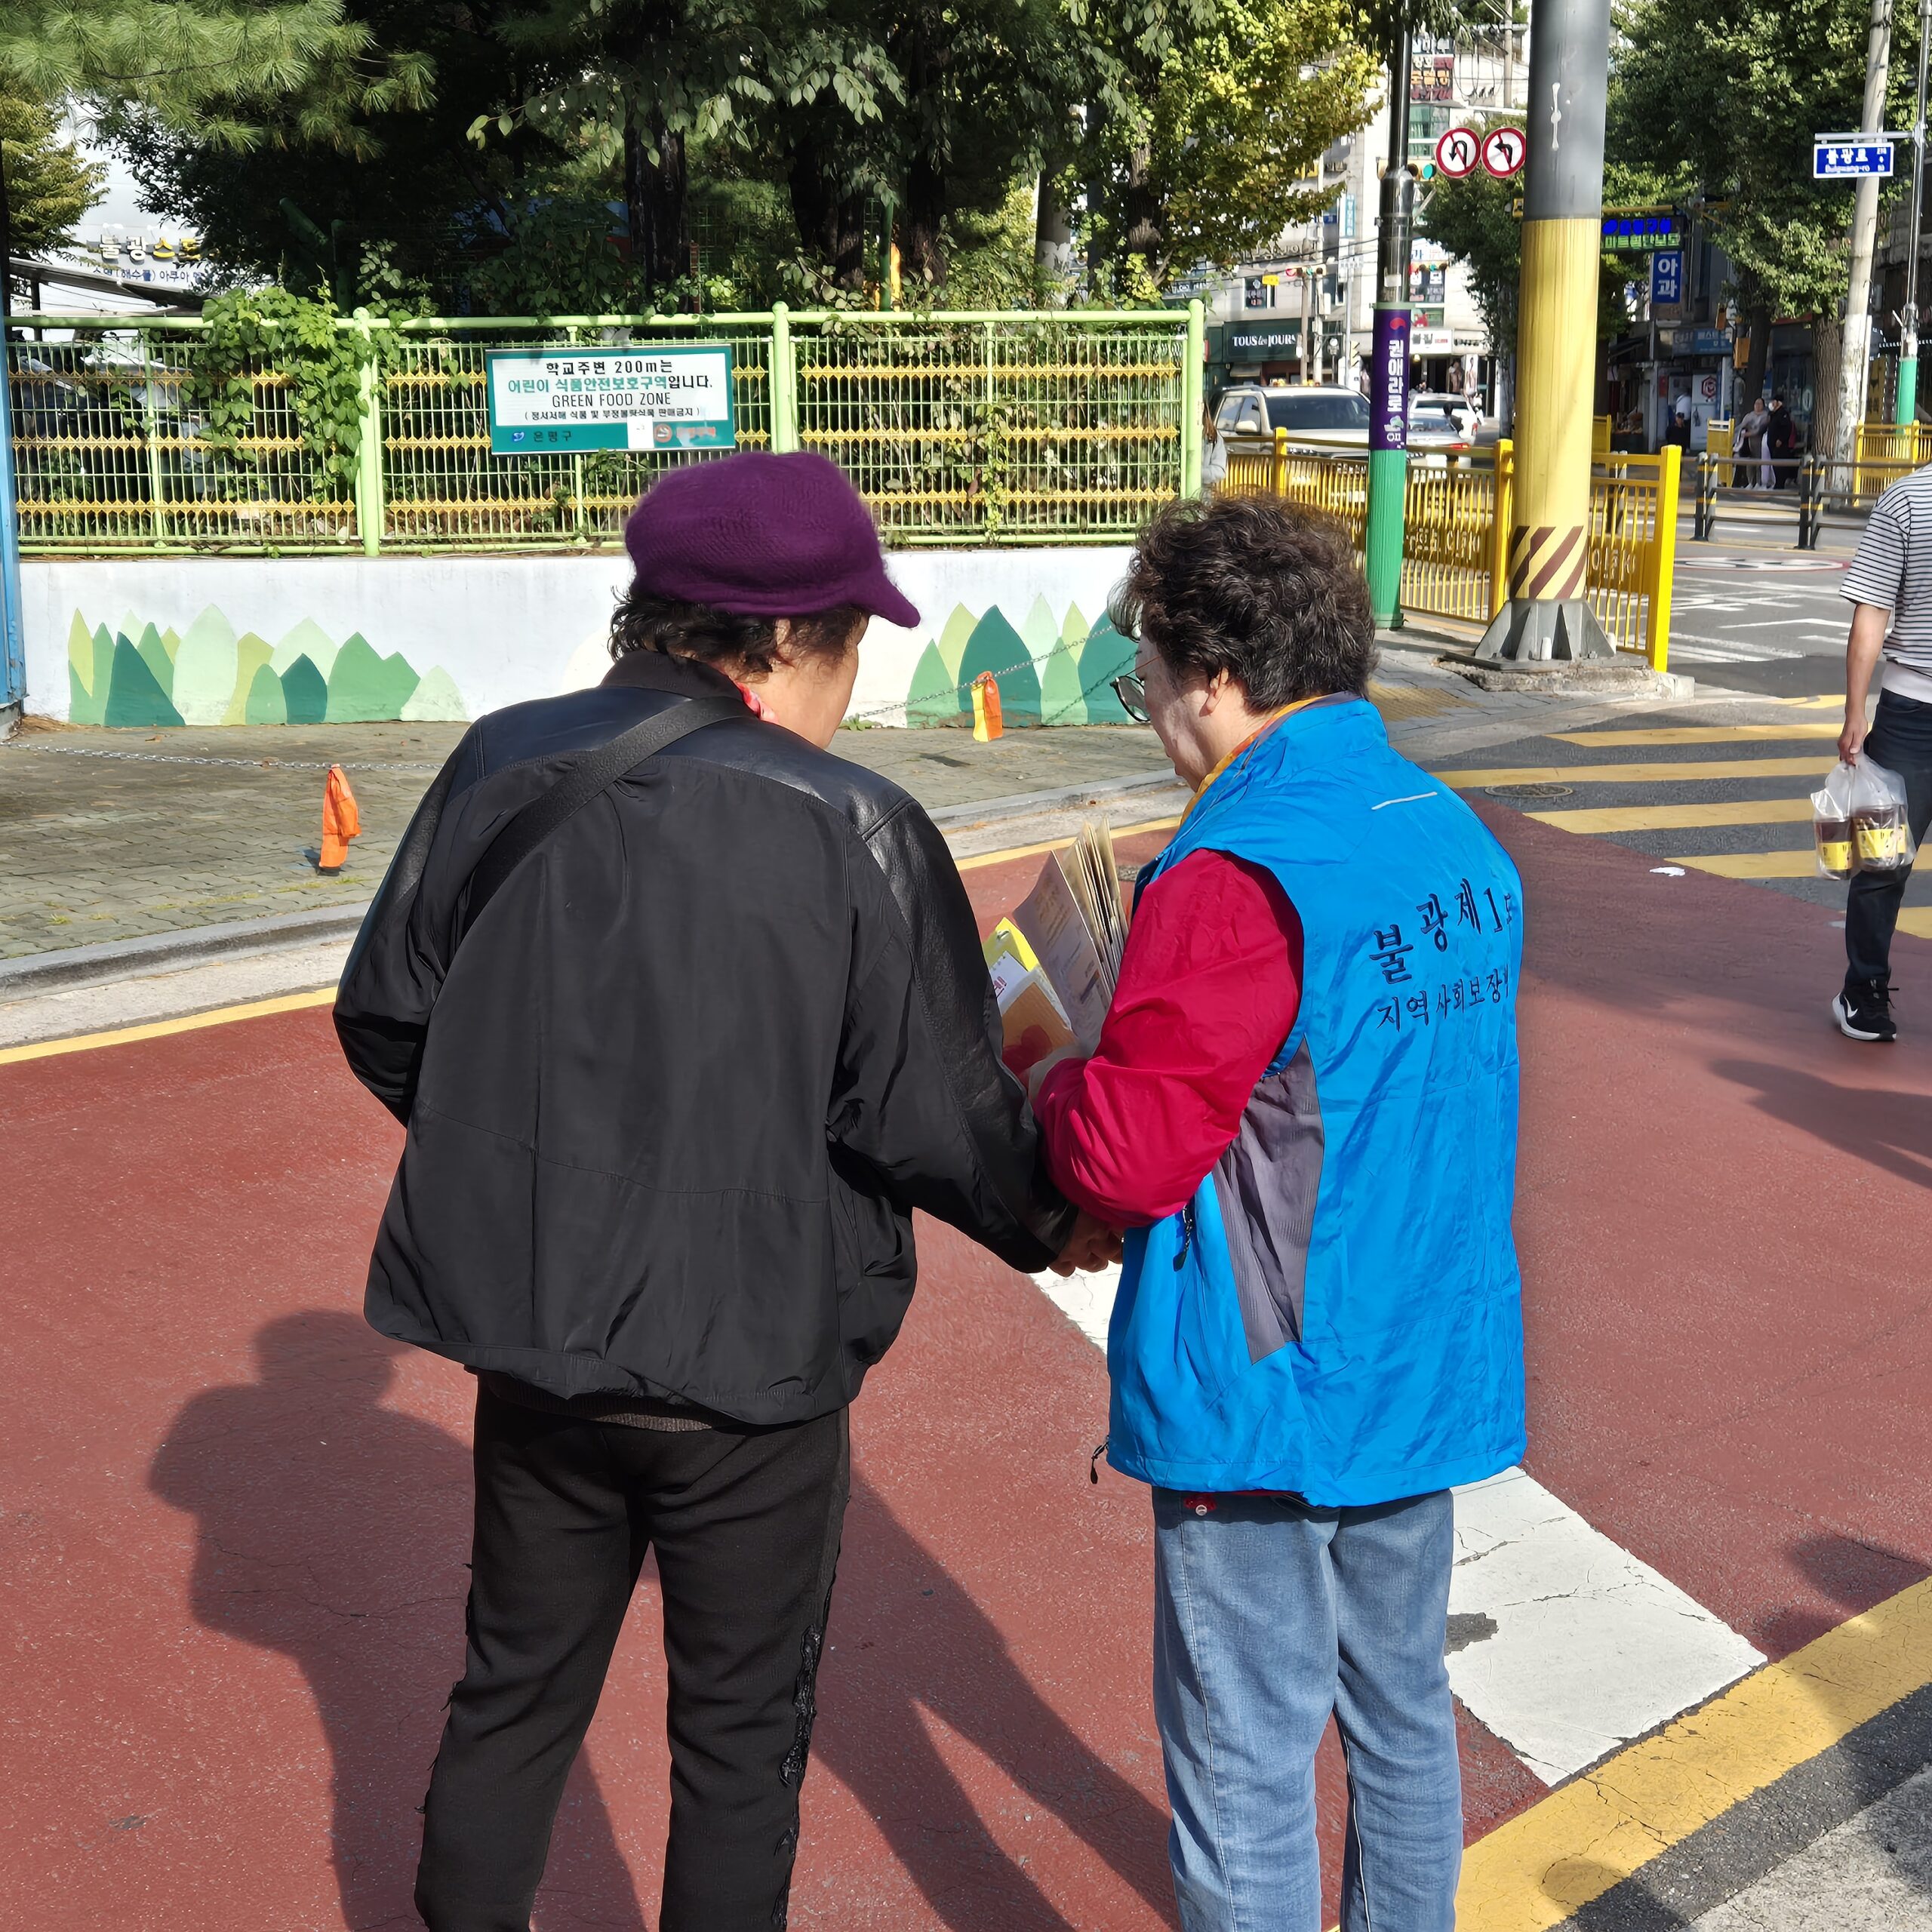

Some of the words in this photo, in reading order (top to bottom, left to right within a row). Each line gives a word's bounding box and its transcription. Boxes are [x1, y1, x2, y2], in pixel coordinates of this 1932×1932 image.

[1232, 335, 1257, 346] TOUS
[546, 361, 607, 376] 학교주변
[614, 359, 673, 374] 200m는
[508, 378, 549, 394] 어린이
[555, 374, 713, 392] 식품안전보호구역입니다.
[552, 394, 593, 408] GREEN
[599, 392, 633, 407] FOOD
[640, 392, 672, 405] ZONE
[533, 429, 574, 442] 은평구
